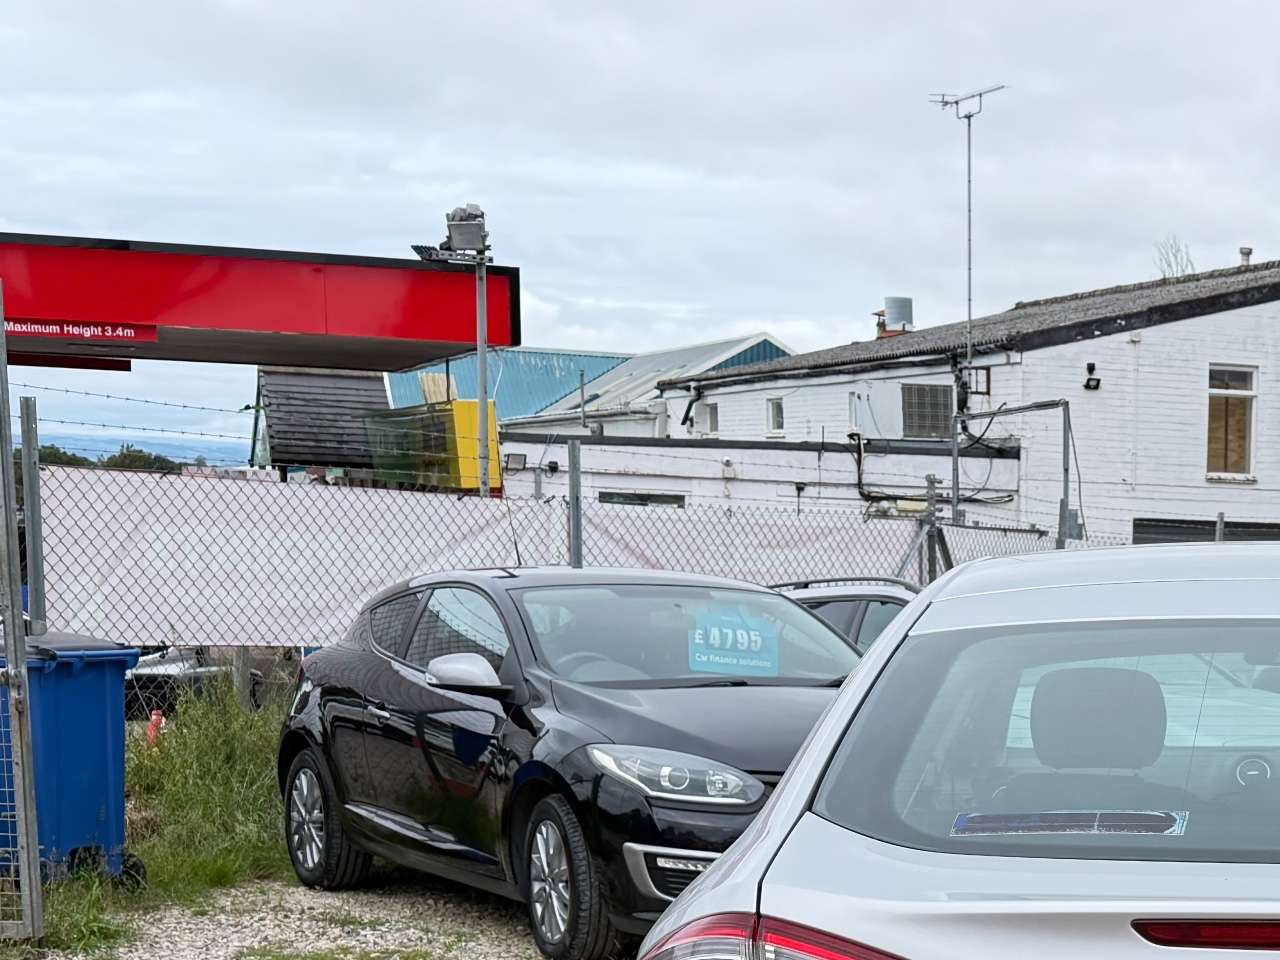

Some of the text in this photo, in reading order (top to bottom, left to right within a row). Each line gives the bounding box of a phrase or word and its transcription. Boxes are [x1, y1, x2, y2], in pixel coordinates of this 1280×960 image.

[4, 321, 135, 337] Maximum Height 3.4m
[695, 652, 708, 662] Car
[710, 654, 738, 664] finance
